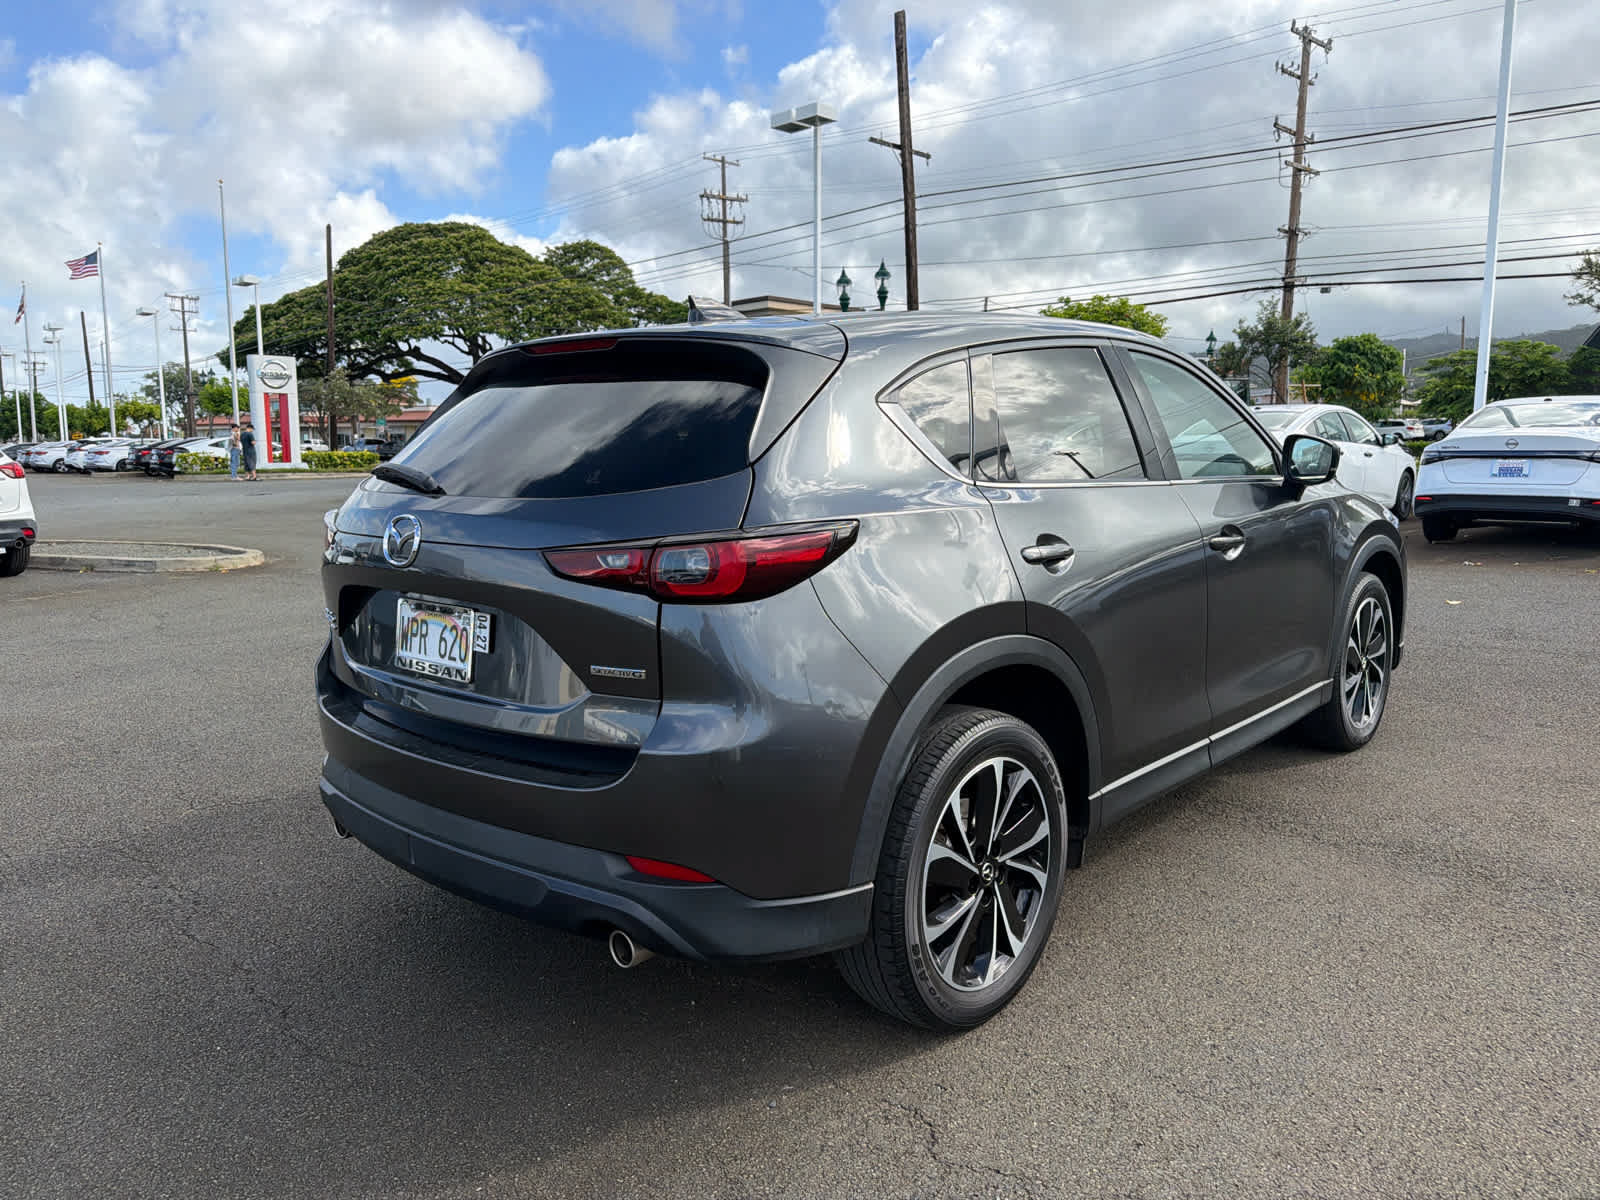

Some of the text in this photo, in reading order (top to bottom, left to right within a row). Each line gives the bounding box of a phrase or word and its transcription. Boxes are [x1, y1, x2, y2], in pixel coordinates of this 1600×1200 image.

[401, 616, 469, 663] WPR 620
[476, 615, 488, 651] 04 27
[398, 656, 467, 681] NISSAN
